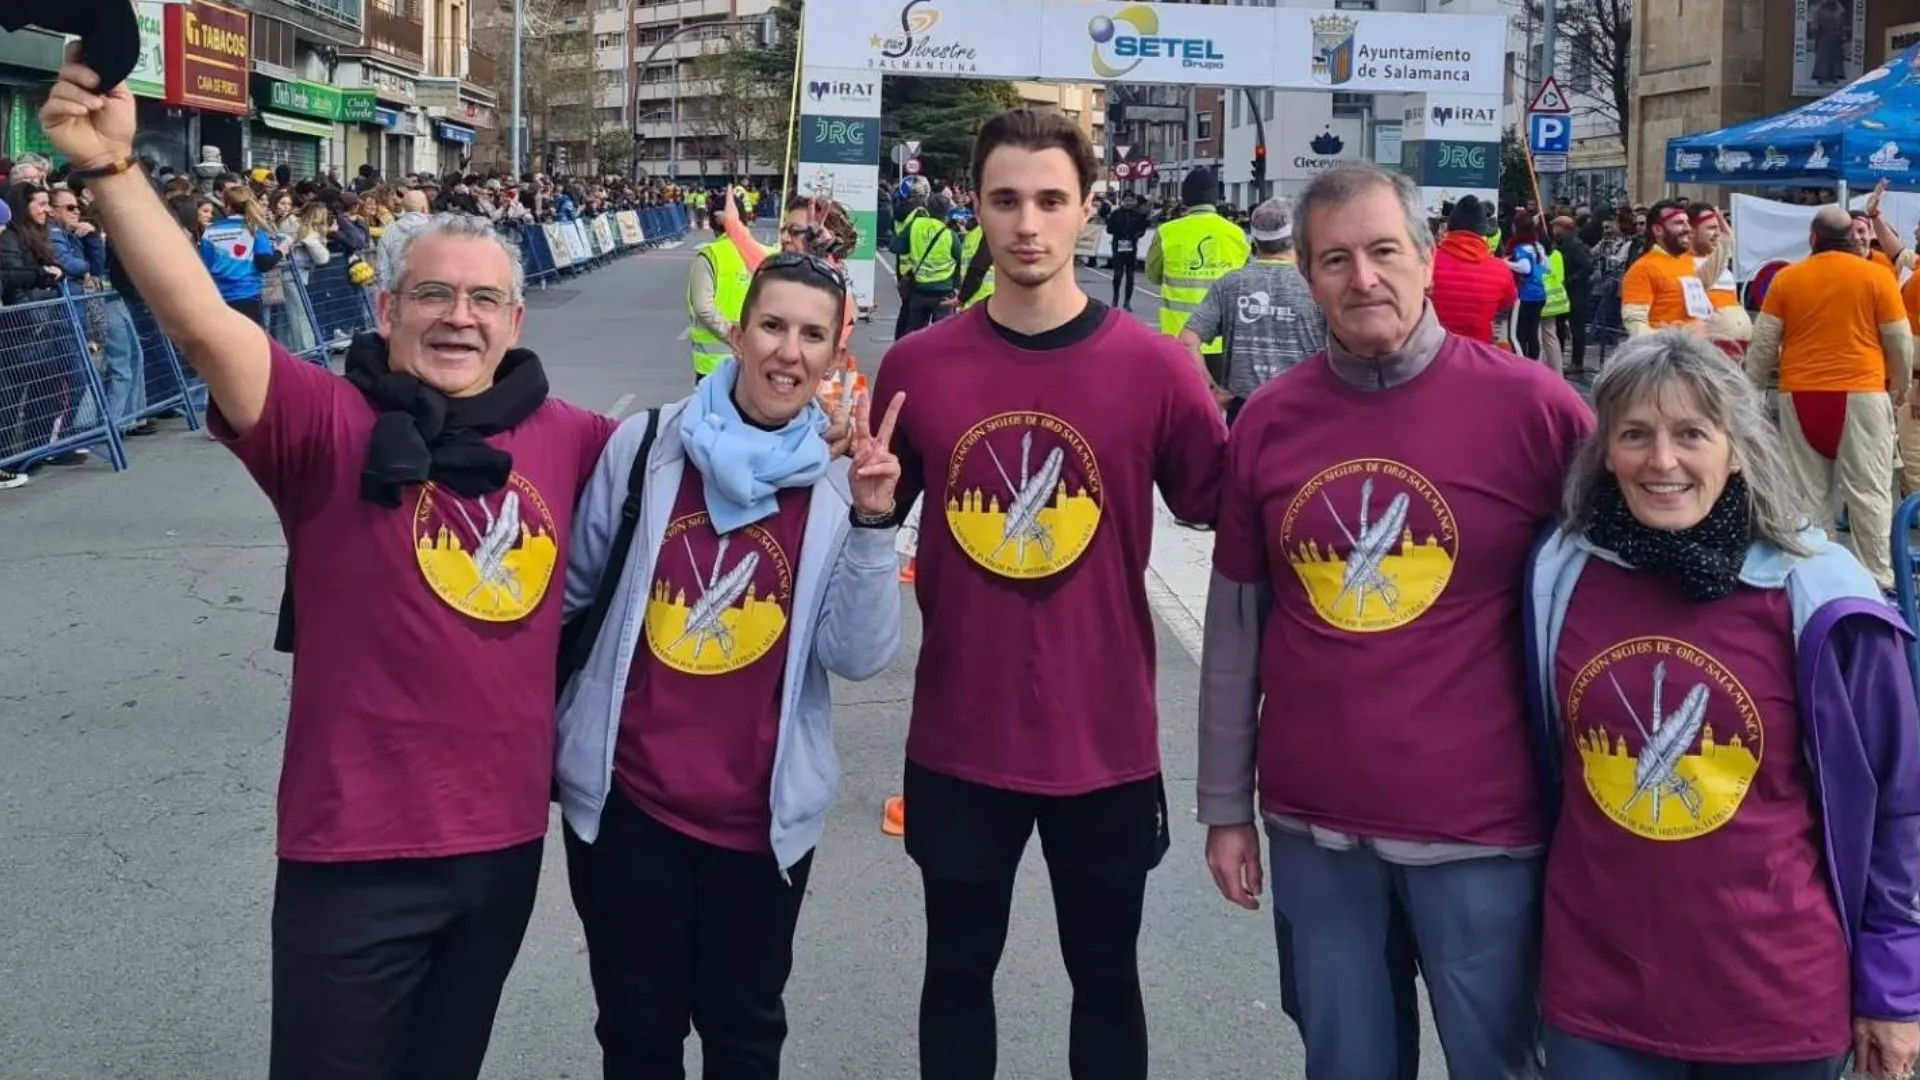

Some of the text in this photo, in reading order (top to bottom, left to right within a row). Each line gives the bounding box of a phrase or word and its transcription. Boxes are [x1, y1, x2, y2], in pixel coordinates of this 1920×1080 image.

[202, 24, 246, 58] TABACOS
[1115, 35, 1224, 60] SETEL
[1358, 43, 1471, 62] Ayuntamiento
[867, 58, 976, 72] SALMANTINA
[1182, 59, 1224, 70] Grupo
[1357, 63, 1470, 81] de Salamanca
[344, 108, 373, 118] Verde
[347, 97, 370, 108] Club
[815, 117, 865, 144] JRG
[1538, 119, 1563, 148] P
[1437, 142, 1486, 169] JRG
[1025, 415, 1038, 425] DE
[1041, 416, 1063, 433] ORO
[1061, 428, 1099, 493] SALAMANCA
[1366, 462, 1379, 473] DE
[1383, 464, 1408, 480] ORO
[1406, 473, 1453, 542] SALAMANCA
[761, 535, 789, 600] SALAMANCA
[1657, 641, 1672, 654] DE
[1676, 645, 1705, 667] ORO
[1704, 660, 1760, 742] SALAMANCA
